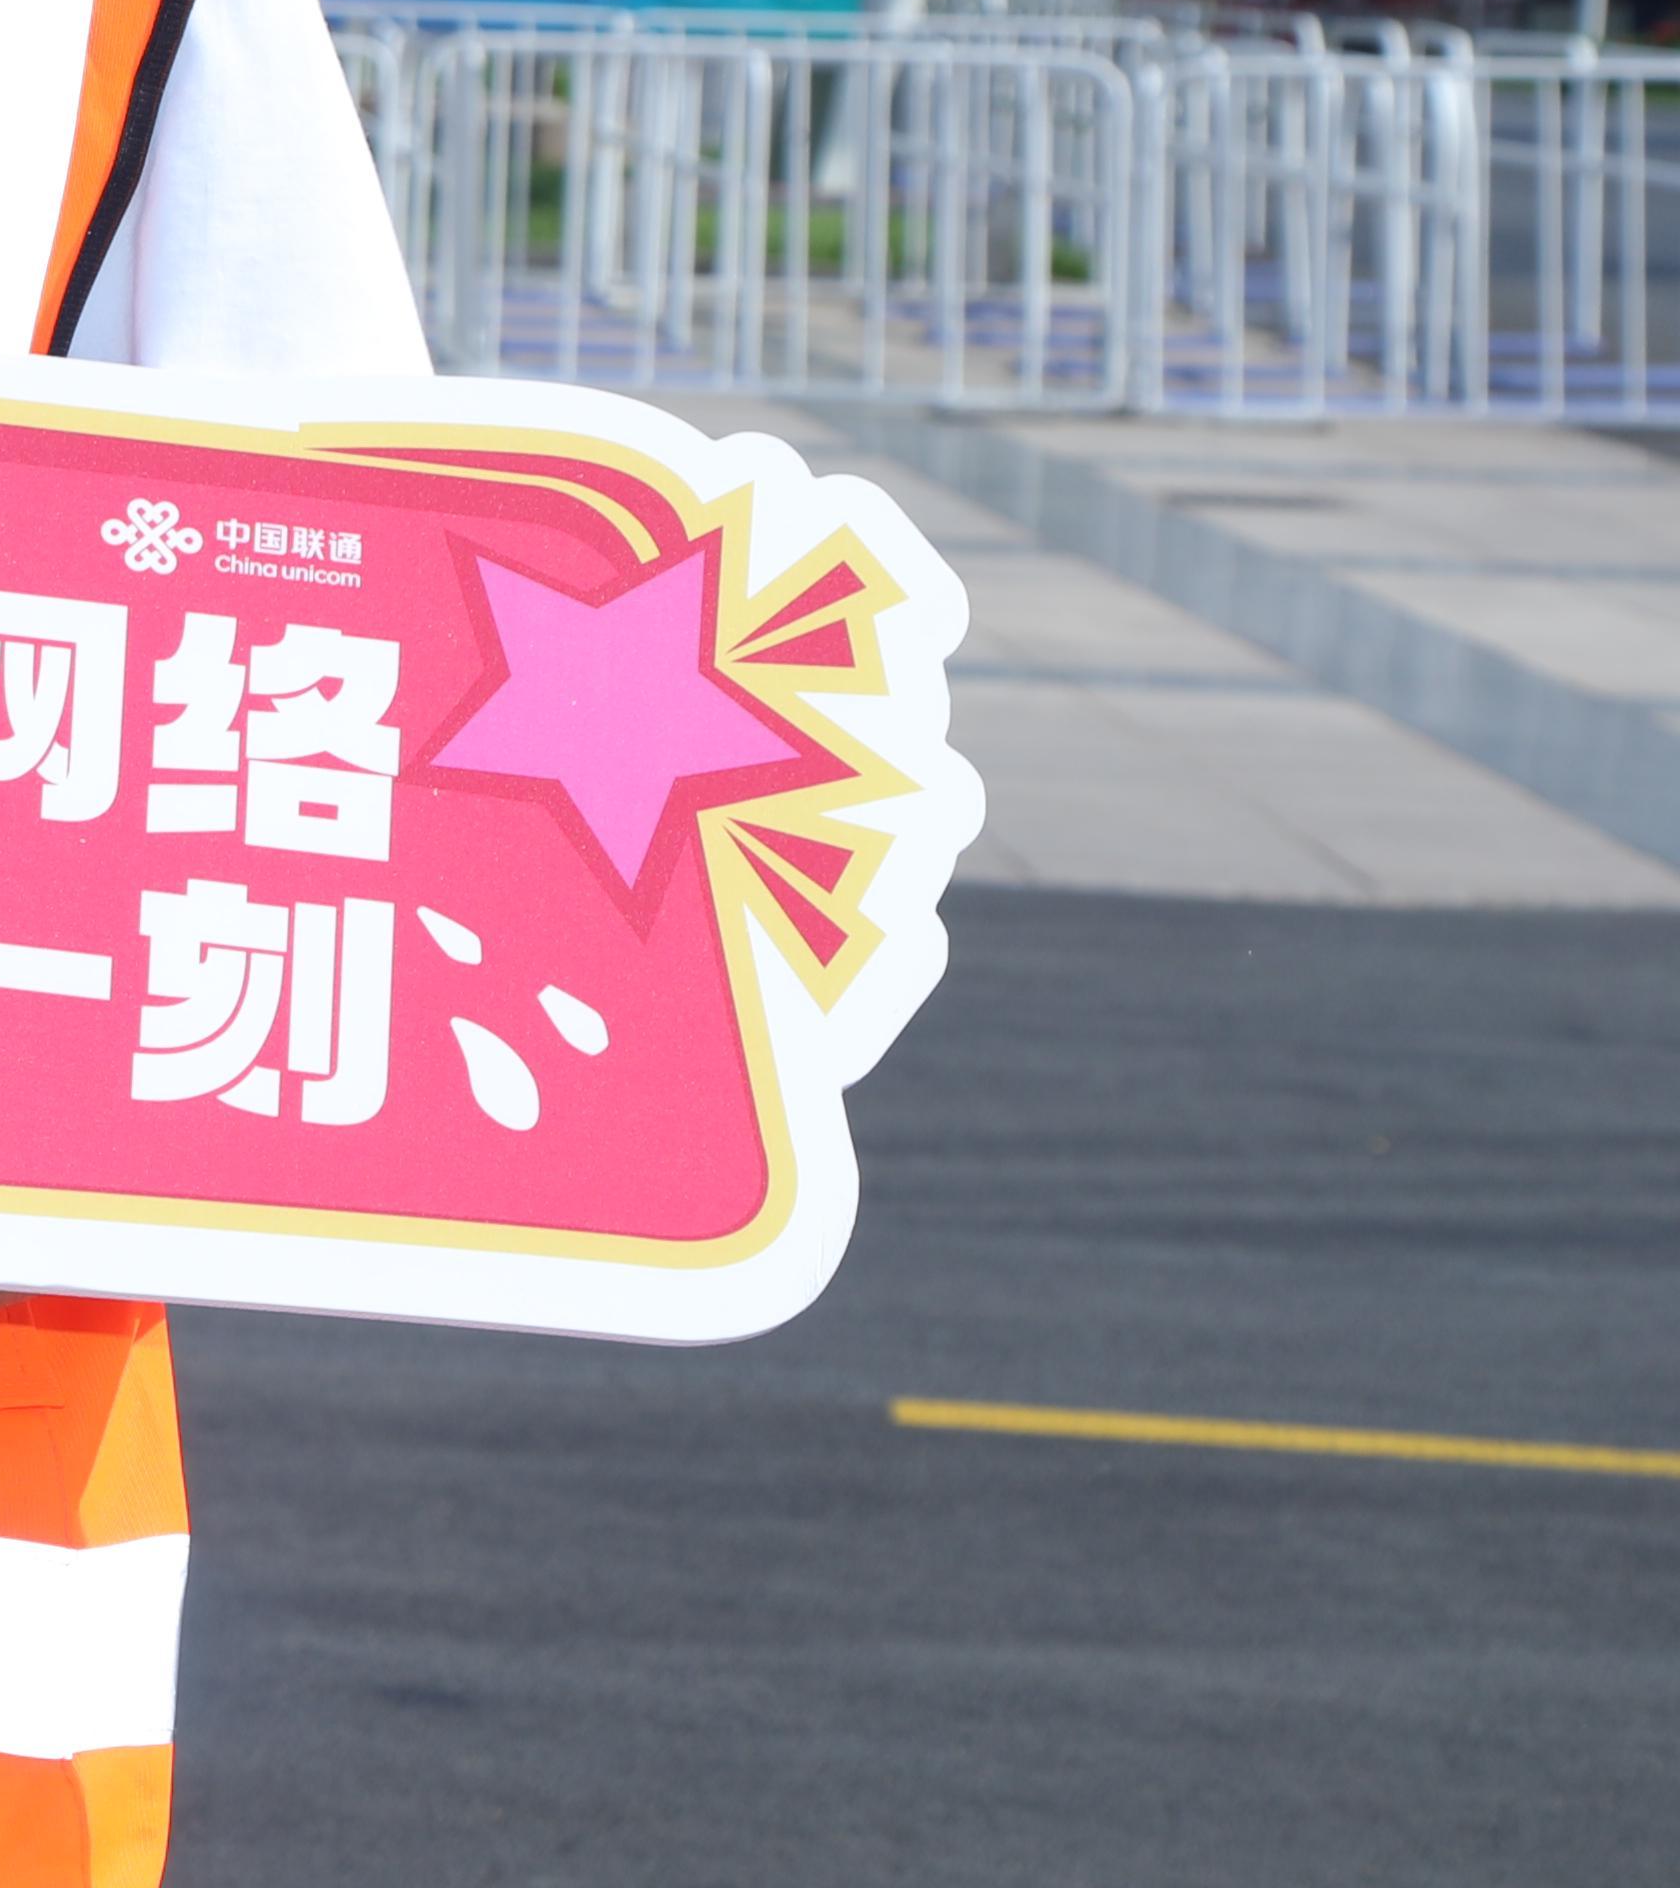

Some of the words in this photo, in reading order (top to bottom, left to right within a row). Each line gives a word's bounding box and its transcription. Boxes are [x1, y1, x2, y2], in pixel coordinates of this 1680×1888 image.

[215, 518, 362, 565] 中国联通
[213, 554, 278, 578] China
[280, 565, 362, 588] unicom
